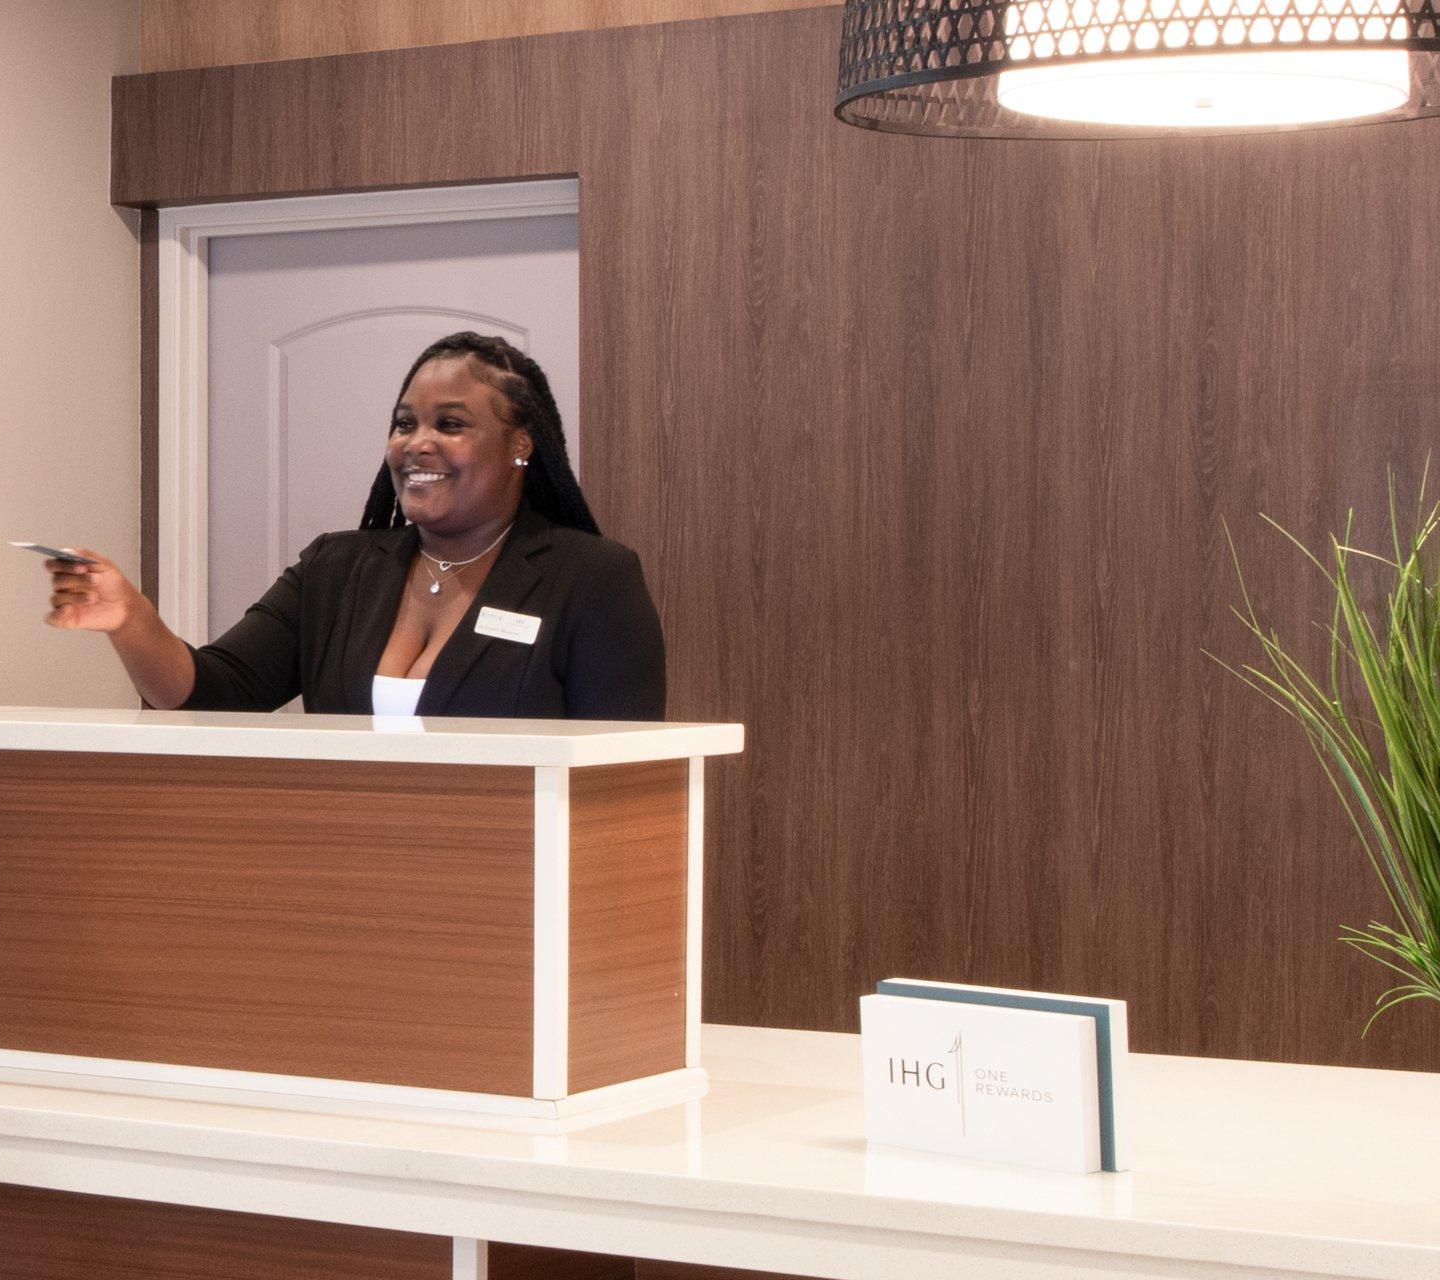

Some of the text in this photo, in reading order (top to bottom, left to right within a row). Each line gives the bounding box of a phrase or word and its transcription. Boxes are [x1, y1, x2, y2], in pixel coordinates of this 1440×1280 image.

[889, 1057, 945, 1090] IHG
[975, 1067, 1008, 1082] ONE
[976, 1083, 1053, 1103] REWARDS
